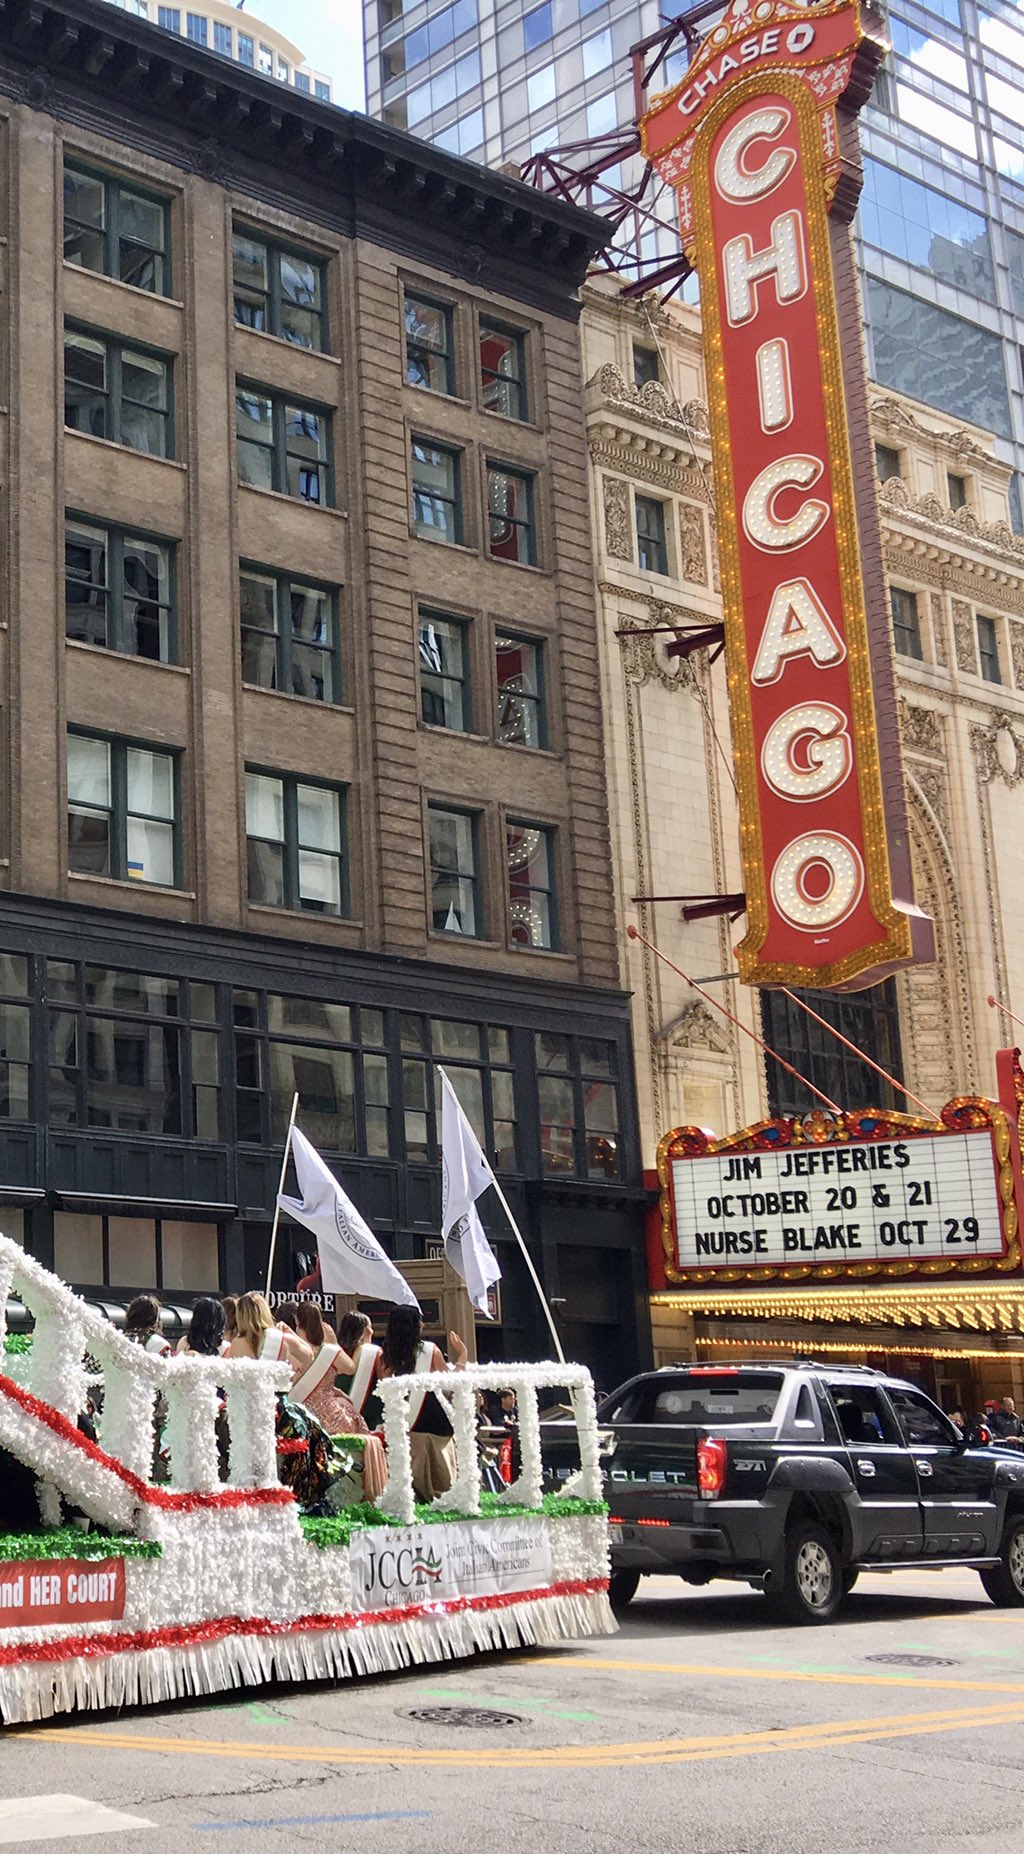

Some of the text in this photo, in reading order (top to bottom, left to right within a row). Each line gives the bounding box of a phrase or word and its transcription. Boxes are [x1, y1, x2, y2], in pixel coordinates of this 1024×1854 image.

[677, 28, 781, 116] CHASE
[714, 105, 865, 934] CHICAGO
[723, 1144, 910, 1181] JIM JEFFERIES
[707, 1181, 933, 1219] OCTOBER 20 & 21
[695, 1217, 980, 1256] NURSE BLAKE OCT 29
[446, 1542, 465, 1559] Joint
[467, 1540, 489, 1557] Civic
[490, 1536, 533, 1554] Committee
[462, 1554, 530, 1576] Italian Americans
[365, 1546, 443, 1592] JCCIA
[30, 1575, 61, 1607] HER
[67, 1572, 117, 1605] COURT
[384, 1589, 426, 1606] CHICAGO
